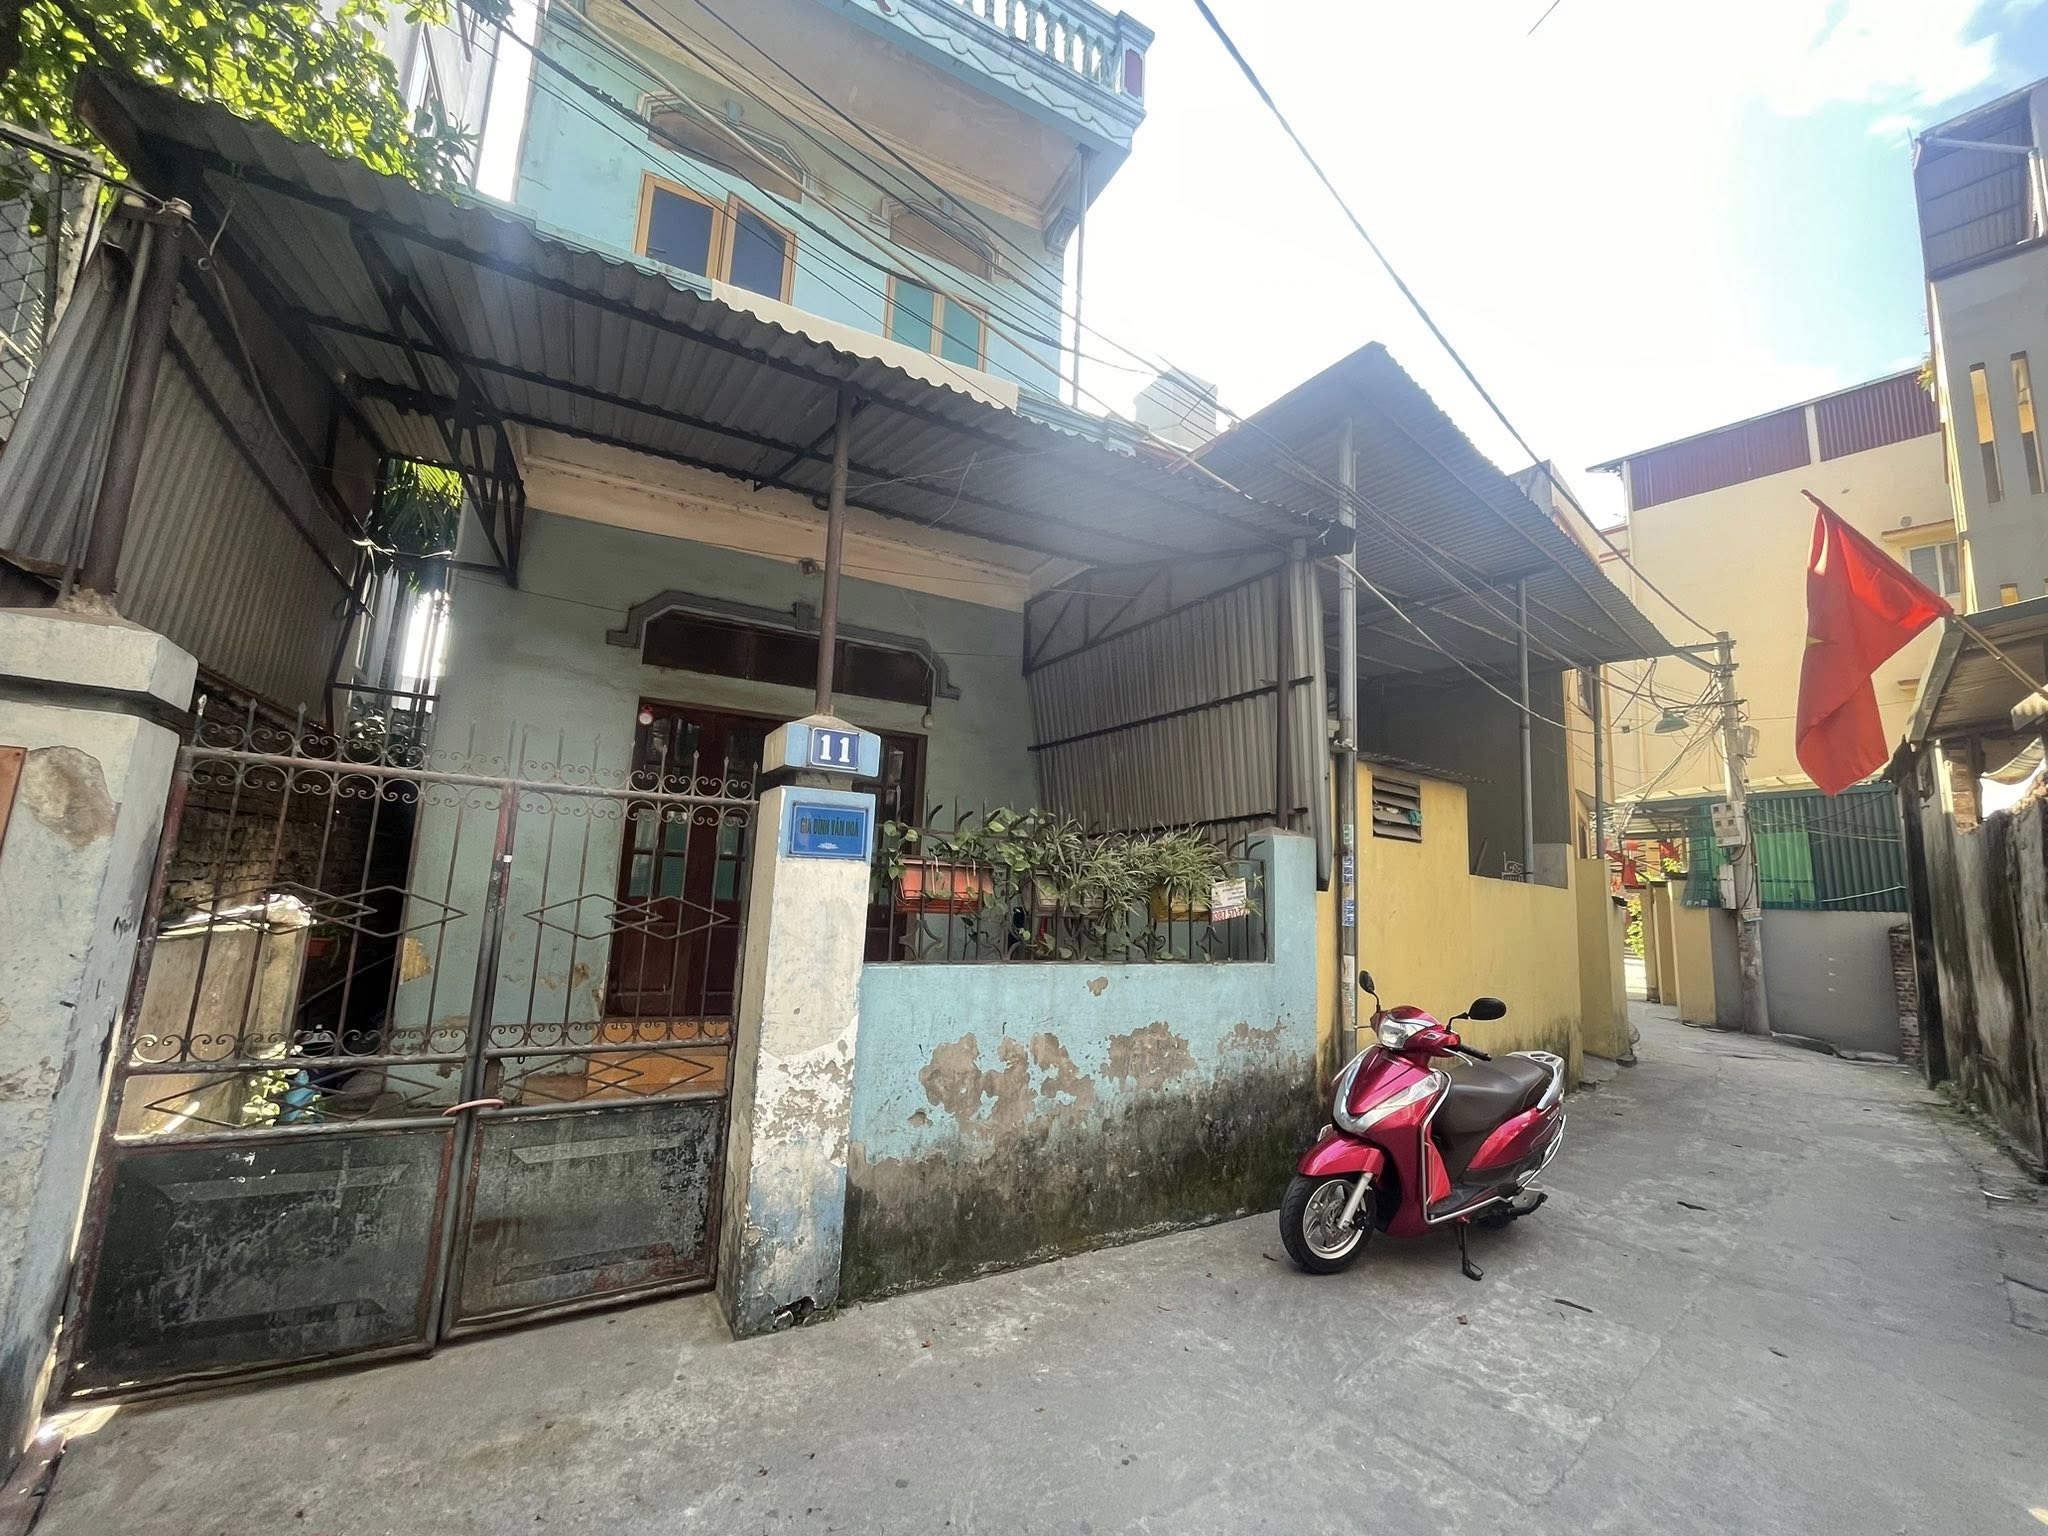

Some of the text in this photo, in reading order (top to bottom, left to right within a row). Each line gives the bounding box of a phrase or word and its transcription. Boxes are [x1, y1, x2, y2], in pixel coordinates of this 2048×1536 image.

[820, 734, 851, 763] 11
[799, 816, 812, 835] GIA
[813, 815, 830, 836] ĐÌNH
[831, 816, 845, 837] VĂN
